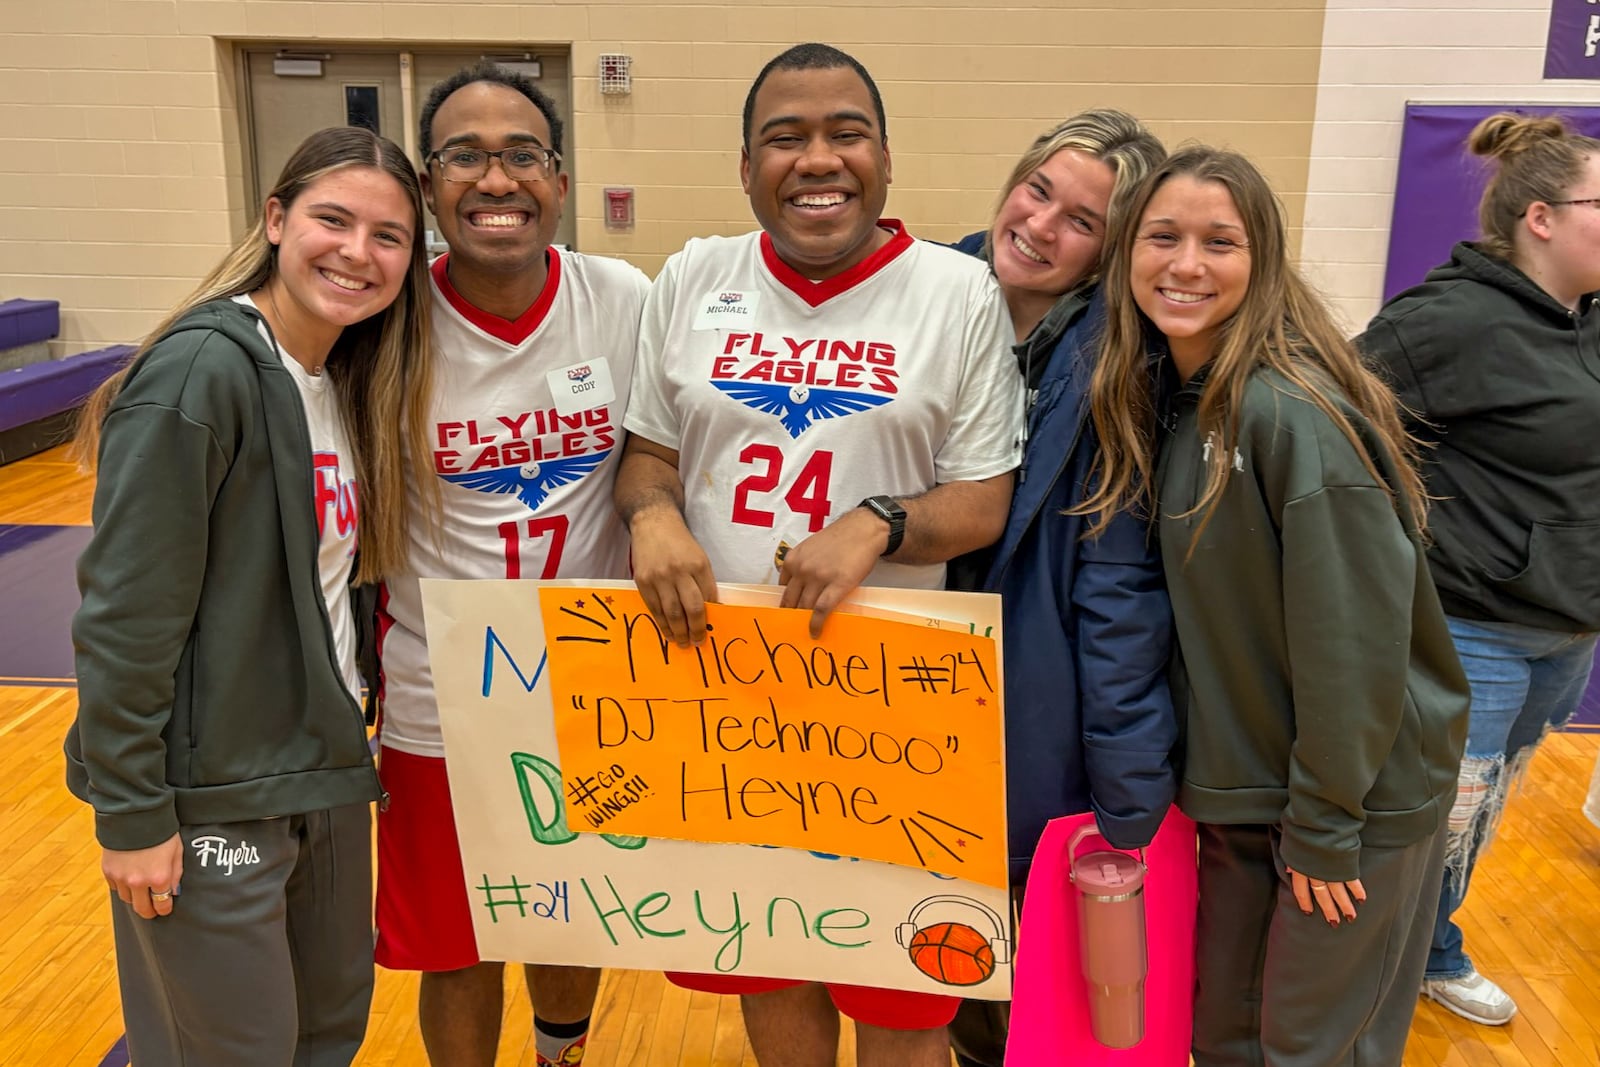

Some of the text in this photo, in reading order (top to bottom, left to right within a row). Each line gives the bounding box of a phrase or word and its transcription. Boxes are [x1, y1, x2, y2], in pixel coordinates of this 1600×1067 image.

[706, 305, 748, 314] MICHAEL
[723, 332, 897, 366] FLYING
[571, 380, 596, 394] CODY
[711, 356, 900, 394] EAGLES
[433, 425, 615, 474] EAGLES
[437, 405, 609, 448] FLYING
[731, 443, 834, 533] 24
[497, 514, 569, 579] 17
[623, 612, 891, 708] Michael
[898, 647, 994, 695] #24
[571, 694, 669, 749] "DJ
[567, 763, 625, 807] #GO
[584, 774, 656, 829] WINGS!!
[681, 761, 893, 832] Heyne
[191, 835, 260, 876] Flyers
[475, 874, 873, 973] #24 Heyne
